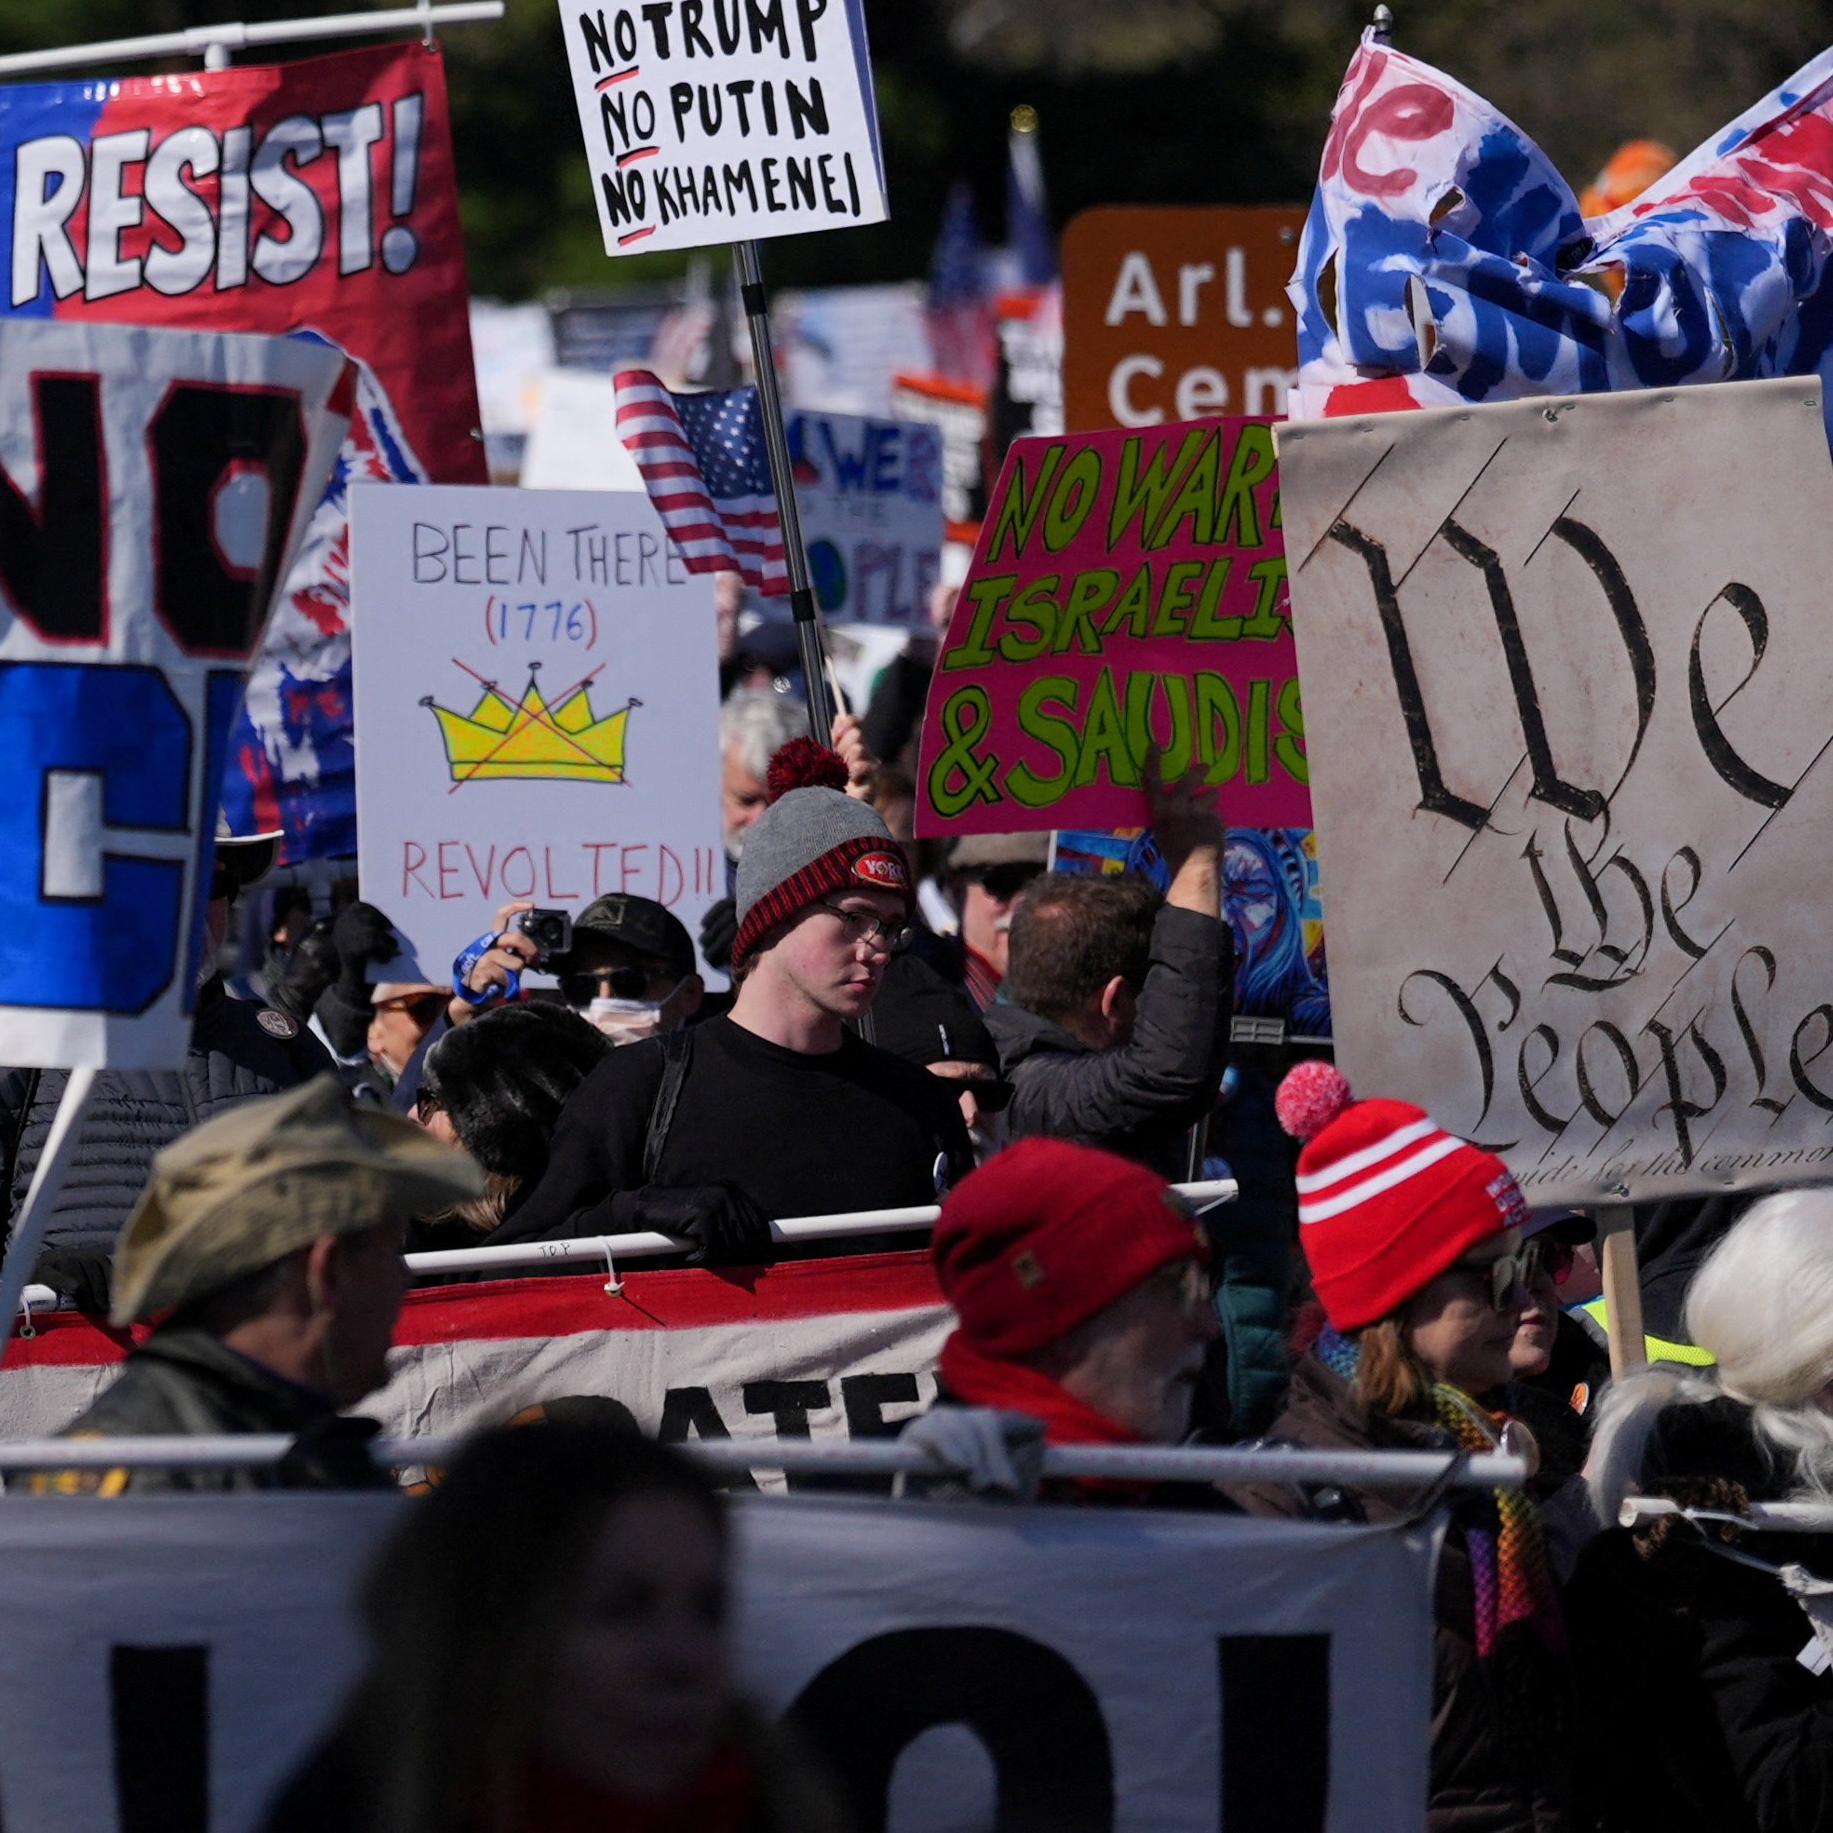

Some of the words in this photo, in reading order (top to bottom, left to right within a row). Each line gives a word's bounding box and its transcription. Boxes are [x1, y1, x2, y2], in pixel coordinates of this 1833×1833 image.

[579, 8, 637, 74] NO
[600, 89, 656, 157] NO
[673, 77, 831, 144] PUTIN
[10, 92, 426, 307] RESIST!
[602, 169, 647, 228] NO
[654, 152, 861, 226] KHAMENEI
[1104, 245, 1284, 327] Arl.
[986, 443, 1103, 564] NO
[1107, 422, 1280, 554] WAR
[412, 522, 548, 586] BEEN
[568, 523, 689, 588] THERE
[484, 594, 598, 650] (1776)
[942, 557, 1295, 673] ISRAELI
[1299, 446, 1831, 876] We
[928, 684, 1003, 819] &
[1003, 665, 1310, 809] SAUDIS
[401, 840, 718, 906] REVOLTED!!
[1520, 809, 1731, 992] the
[1397, 946, 1833, 1168] People
